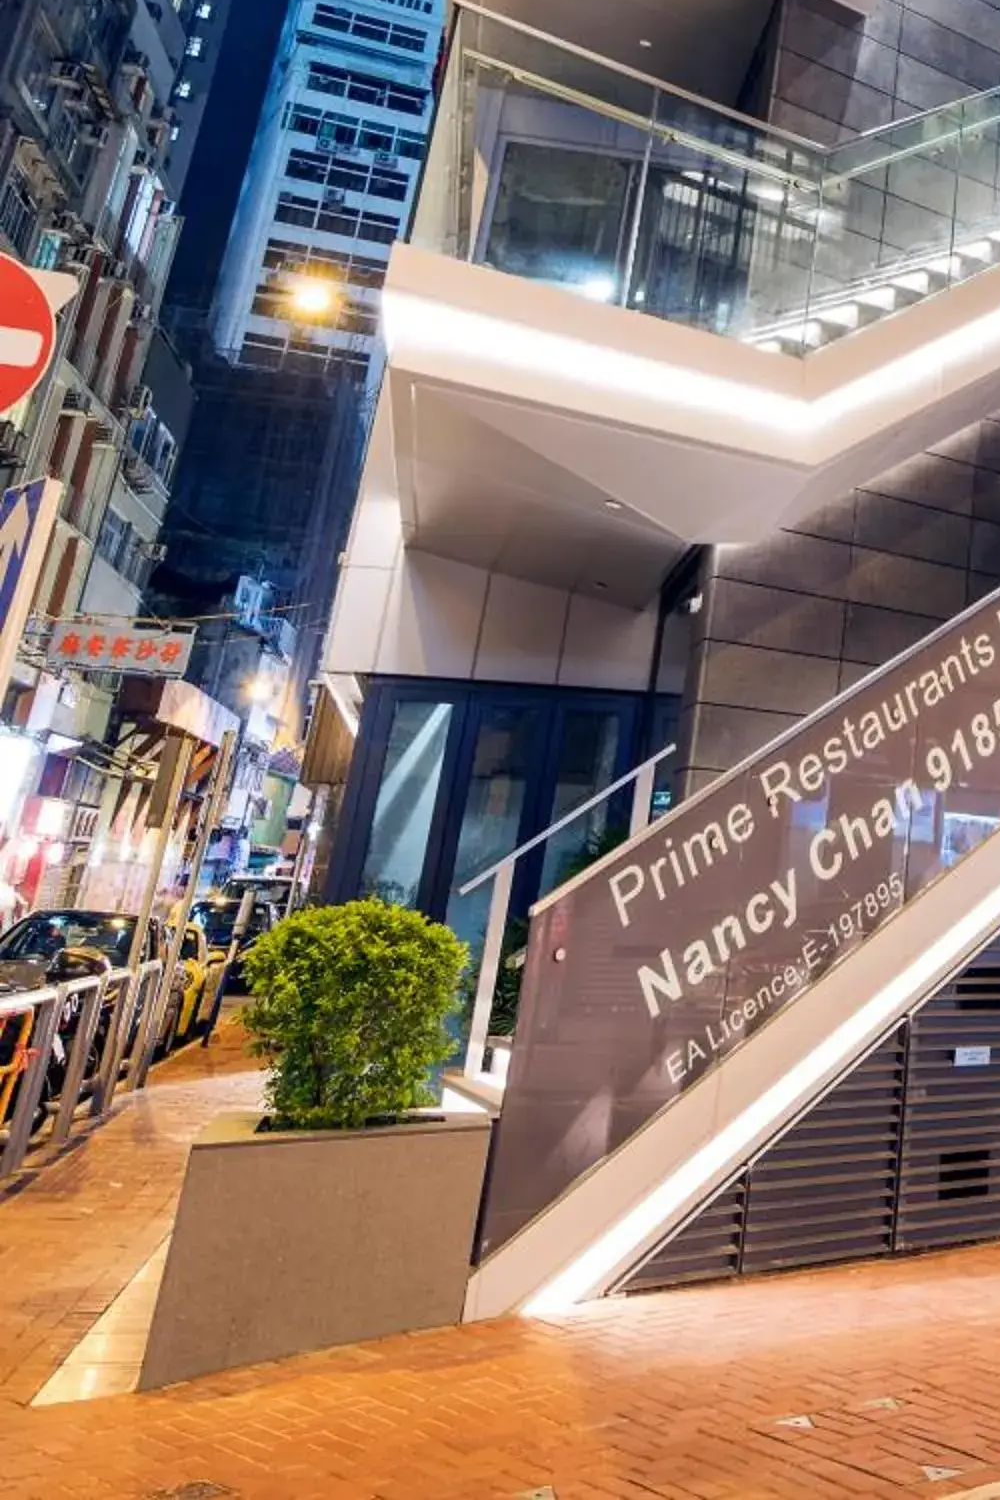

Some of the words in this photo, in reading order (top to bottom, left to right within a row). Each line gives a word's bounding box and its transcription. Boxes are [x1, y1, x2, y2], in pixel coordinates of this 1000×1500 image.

[608, 803, 755, 928] Prime
[761, 629, 995, 818] Restaurants
[637, 867, 798, 1019] Nancy
[809, 778, 924, 881] Chan
[666, 1038, 705, 1084] EA
